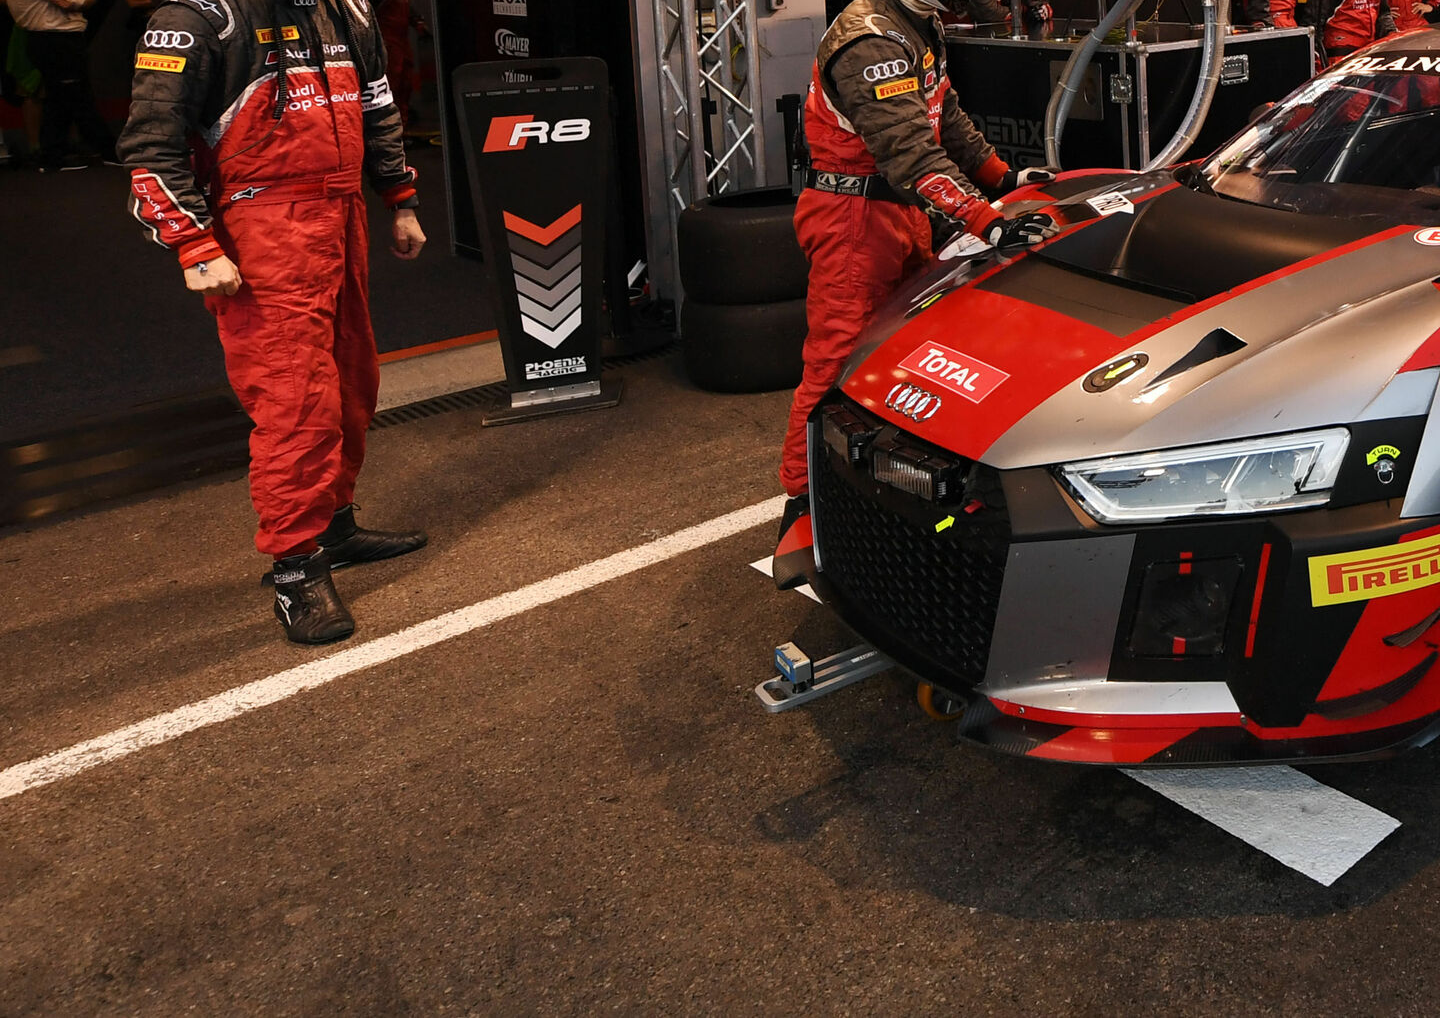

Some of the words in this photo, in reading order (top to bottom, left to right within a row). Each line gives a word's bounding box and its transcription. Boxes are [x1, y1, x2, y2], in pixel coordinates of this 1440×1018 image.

[505, 36, 530, 52] MAYER
[137, 55, 180, 70] PIRELLI
[879, 80, 915, 97] PIRELLI
[508, 118, 591, 146] R8
[917, 348, 980, 392] TOTAL
[1371, 446, 1398, 457] TURN
